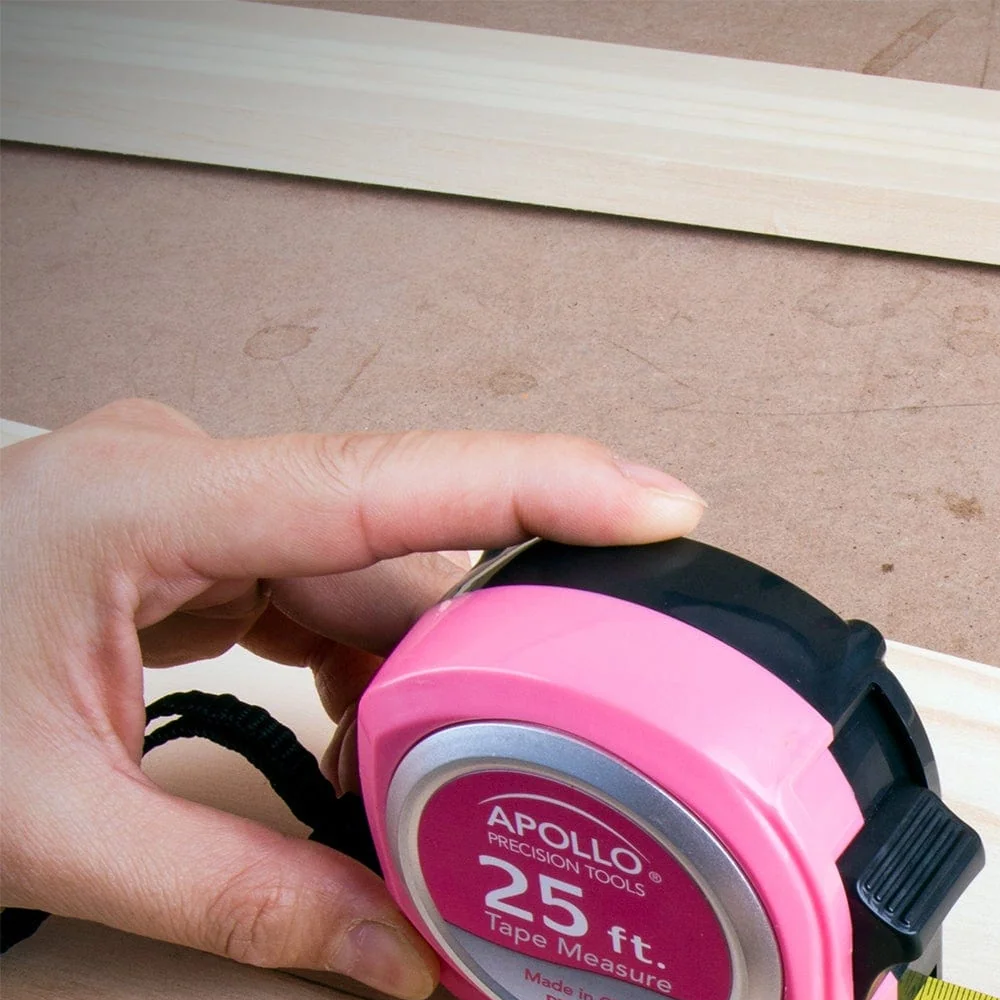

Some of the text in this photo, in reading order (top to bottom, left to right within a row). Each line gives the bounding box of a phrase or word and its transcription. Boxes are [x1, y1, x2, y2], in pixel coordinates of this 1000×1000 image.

[487, 805, 643, 876] APOLLO
[487, 831, 646, 897] PRECISION TOOLS
[478, 854, 666, 970] 25 ft.
[484, 910, 673, 994] Tape Measure
[524, 967, 573, 997] Made
